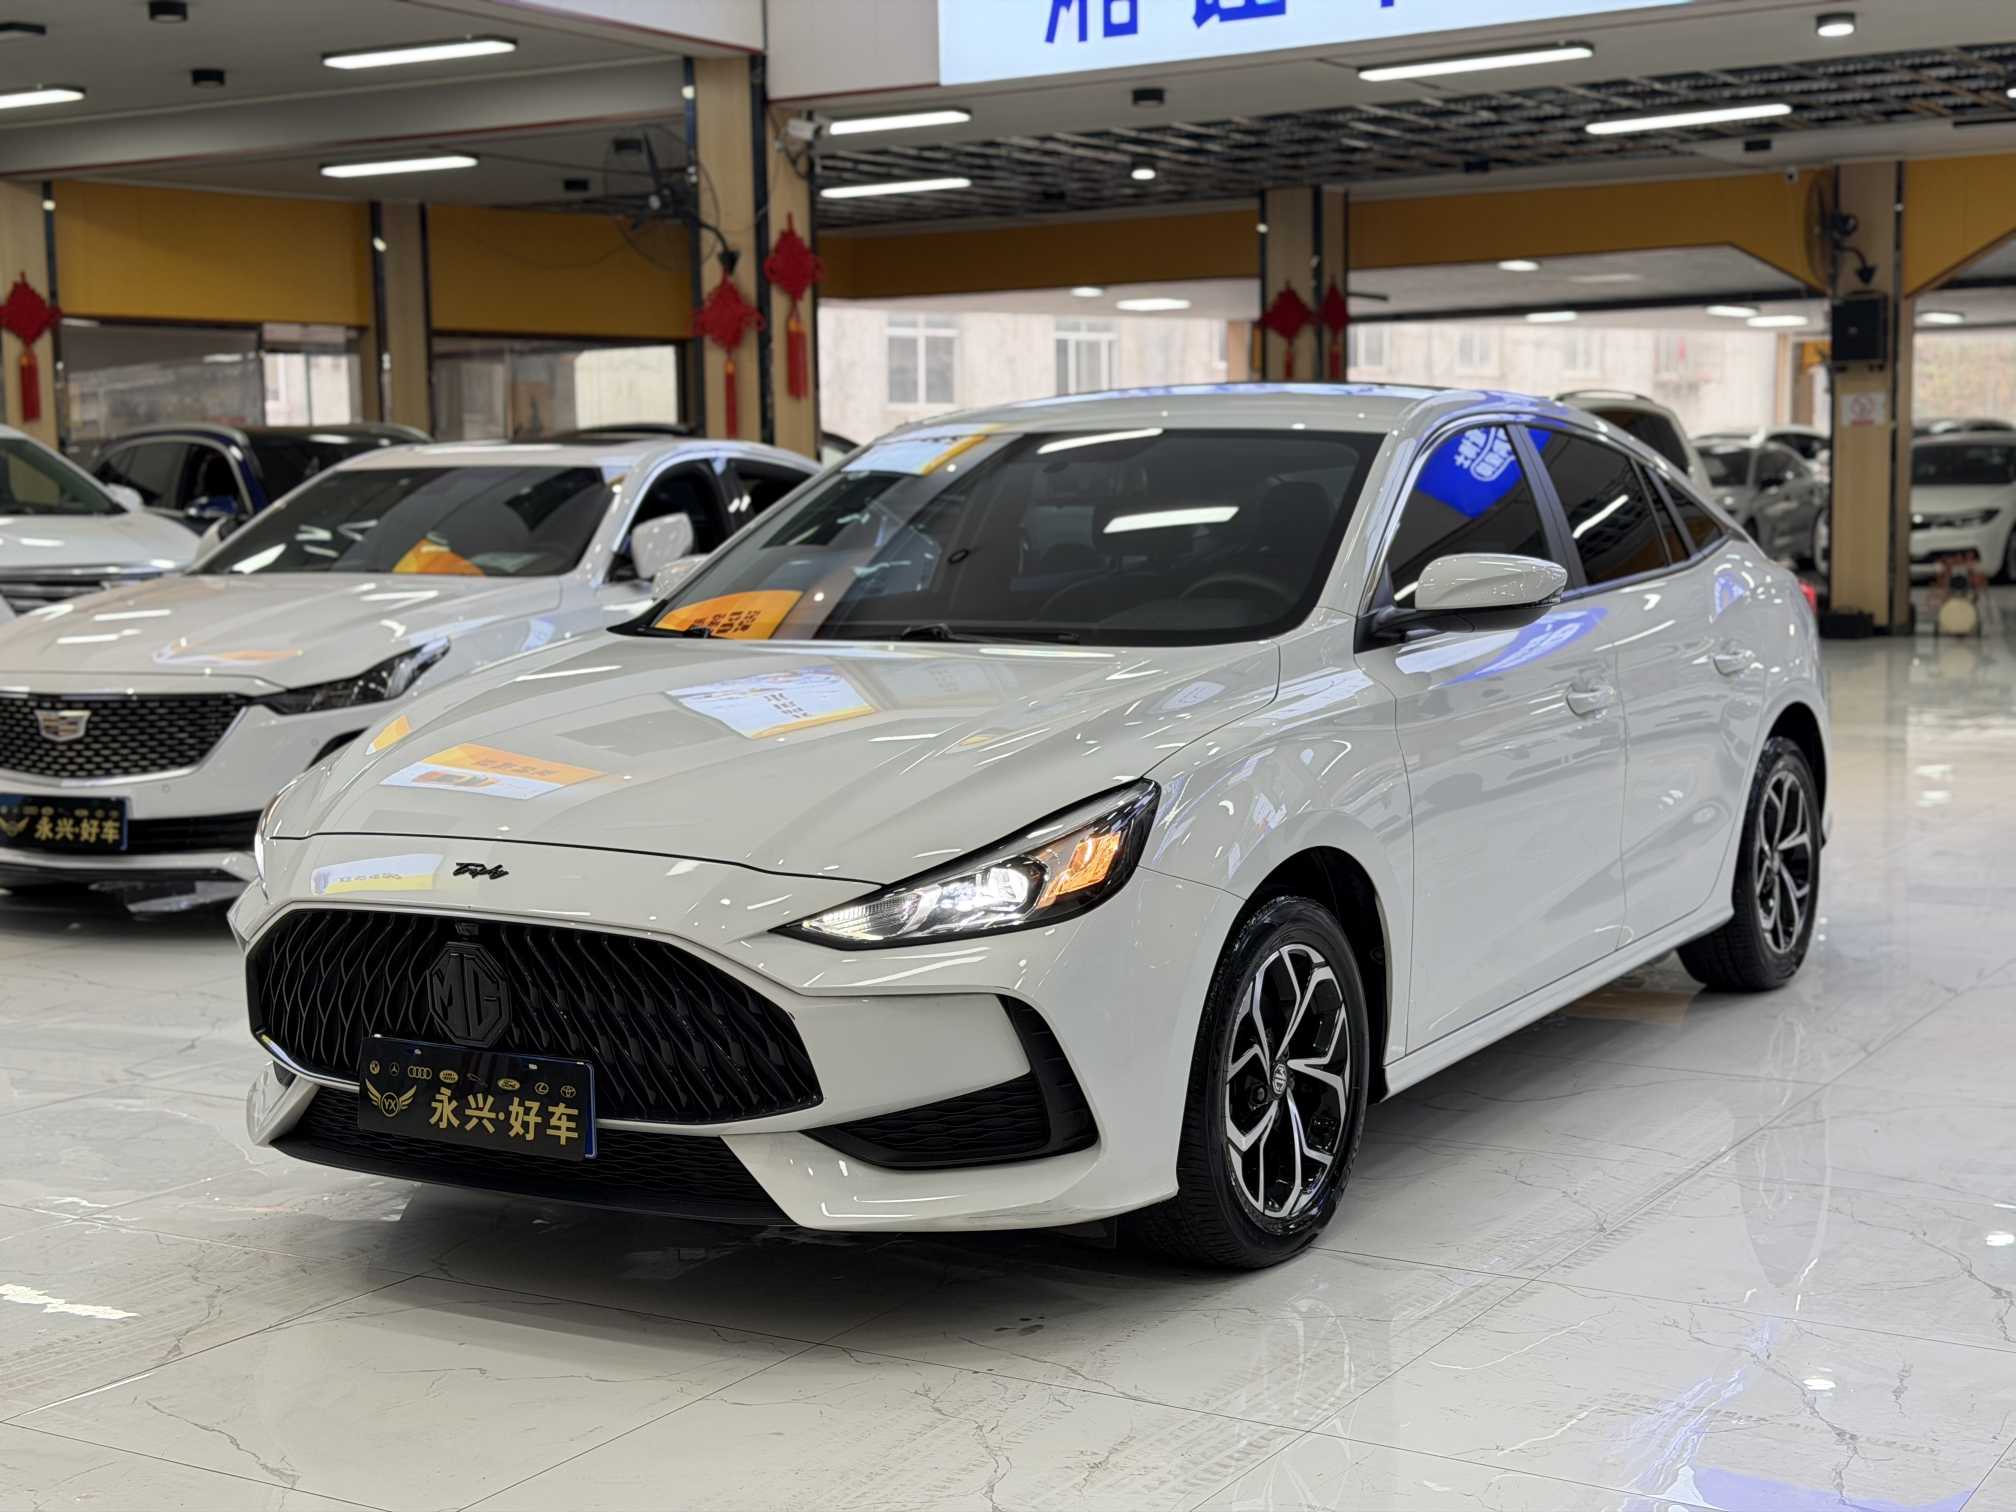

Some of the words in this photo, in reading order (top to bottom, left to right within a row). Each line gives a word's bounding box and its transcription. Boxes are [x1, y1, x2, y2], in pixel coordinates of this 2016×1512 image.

[430, 951, 501, 1043] MG
[428, 1087, 579, 1145] 永兴·好车
